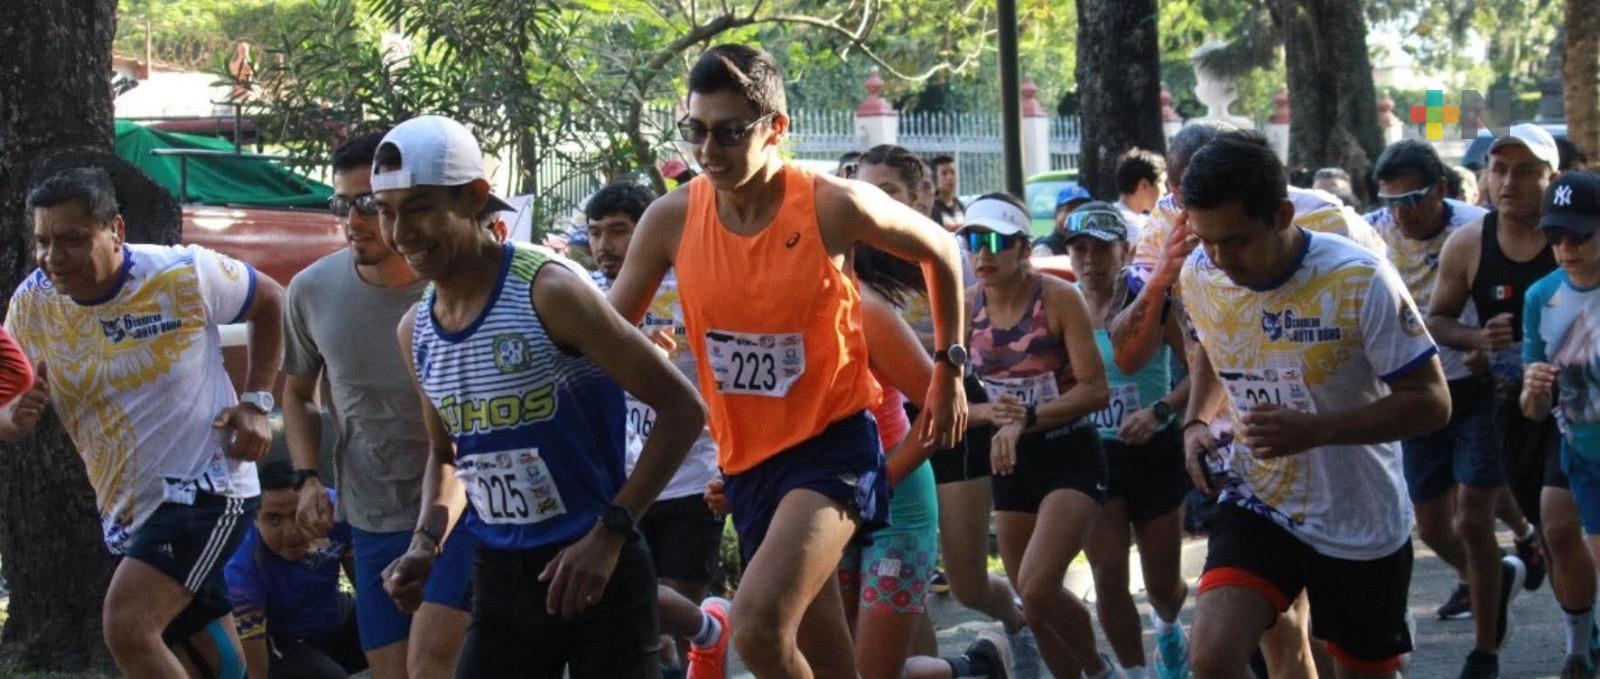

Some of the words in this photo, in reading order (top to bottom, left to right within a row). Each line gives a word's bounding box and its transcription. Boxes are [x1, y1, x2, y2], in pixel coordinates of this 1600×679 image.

[1553, 184, 1573, 206] NY
[1285, 309, 1293, 329] 6
[731, 351, 776, 391] 223
[478, 474, 529, 518] 225
